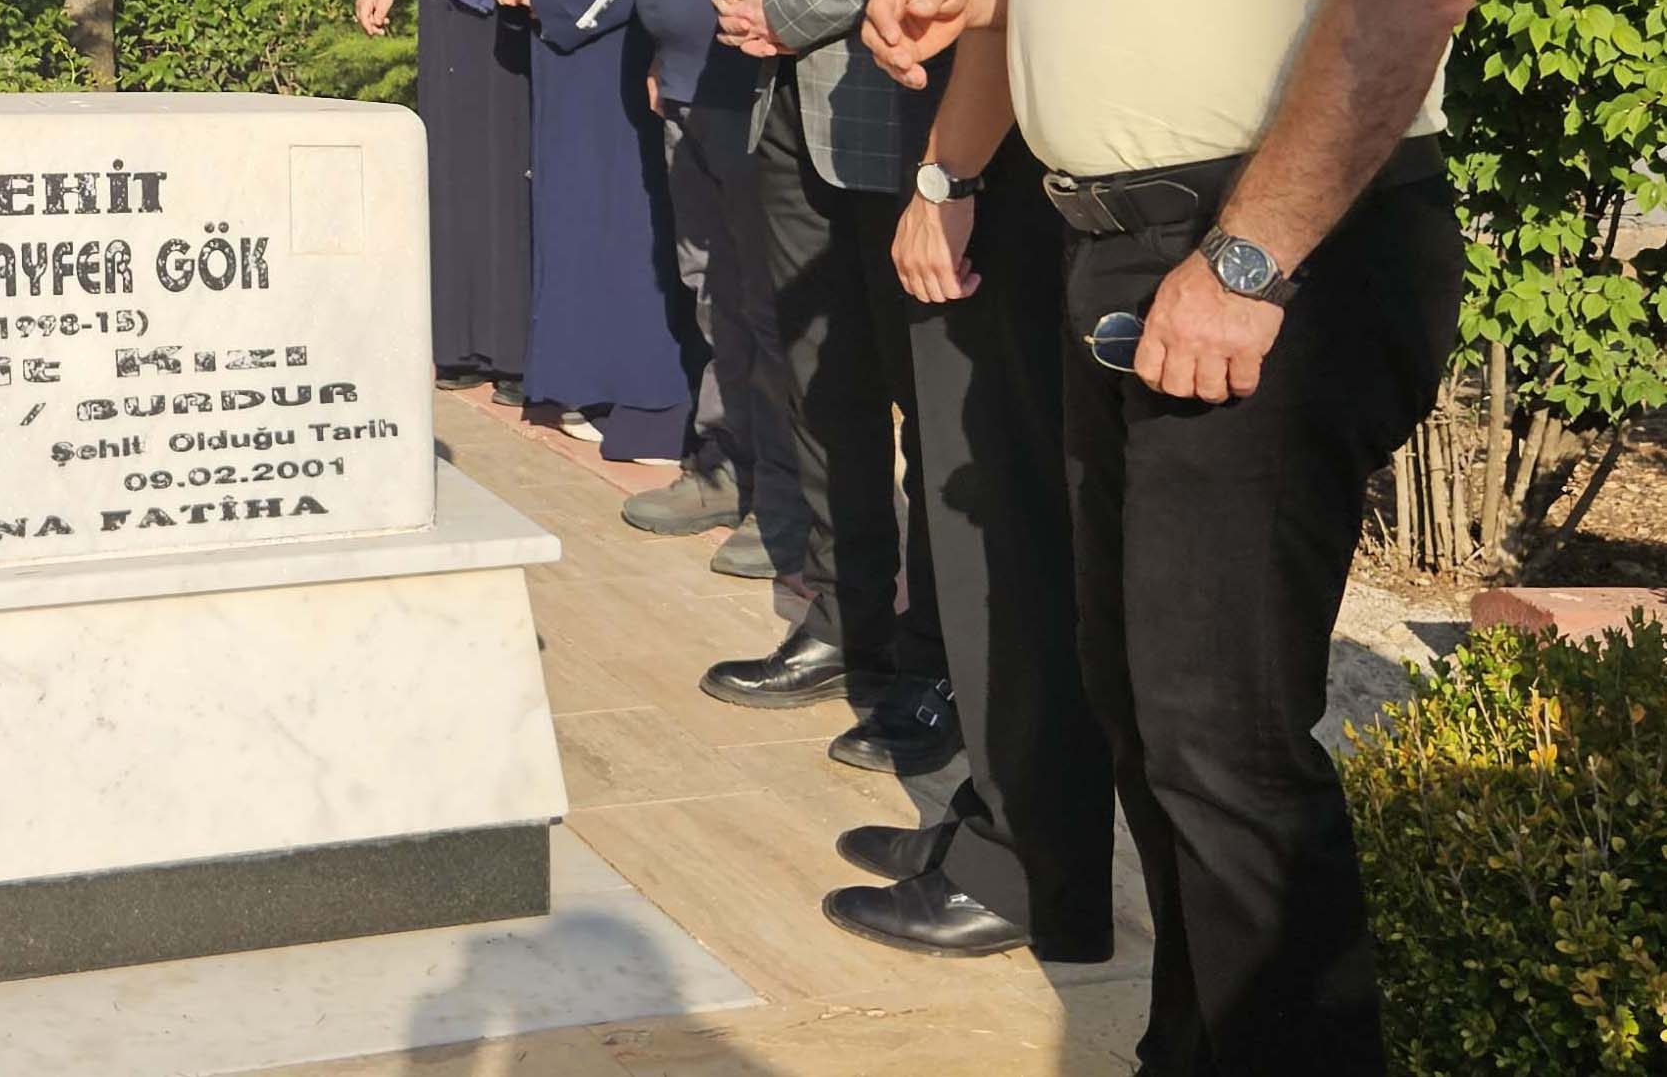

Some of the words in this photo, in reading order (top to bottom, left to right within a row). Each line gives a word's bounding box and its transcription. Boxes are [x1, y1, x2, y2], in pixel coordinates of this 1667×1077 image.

[155, 220, 270, 294] GÖK
[20, 402, 47, 427] /
[76, 381, 360, 423] BURDUR
[168, 426, 297, 453] Olduğu
[308, 418, 400, 443] Tarih
[123, 456, 346, 492] 09.02.2001
